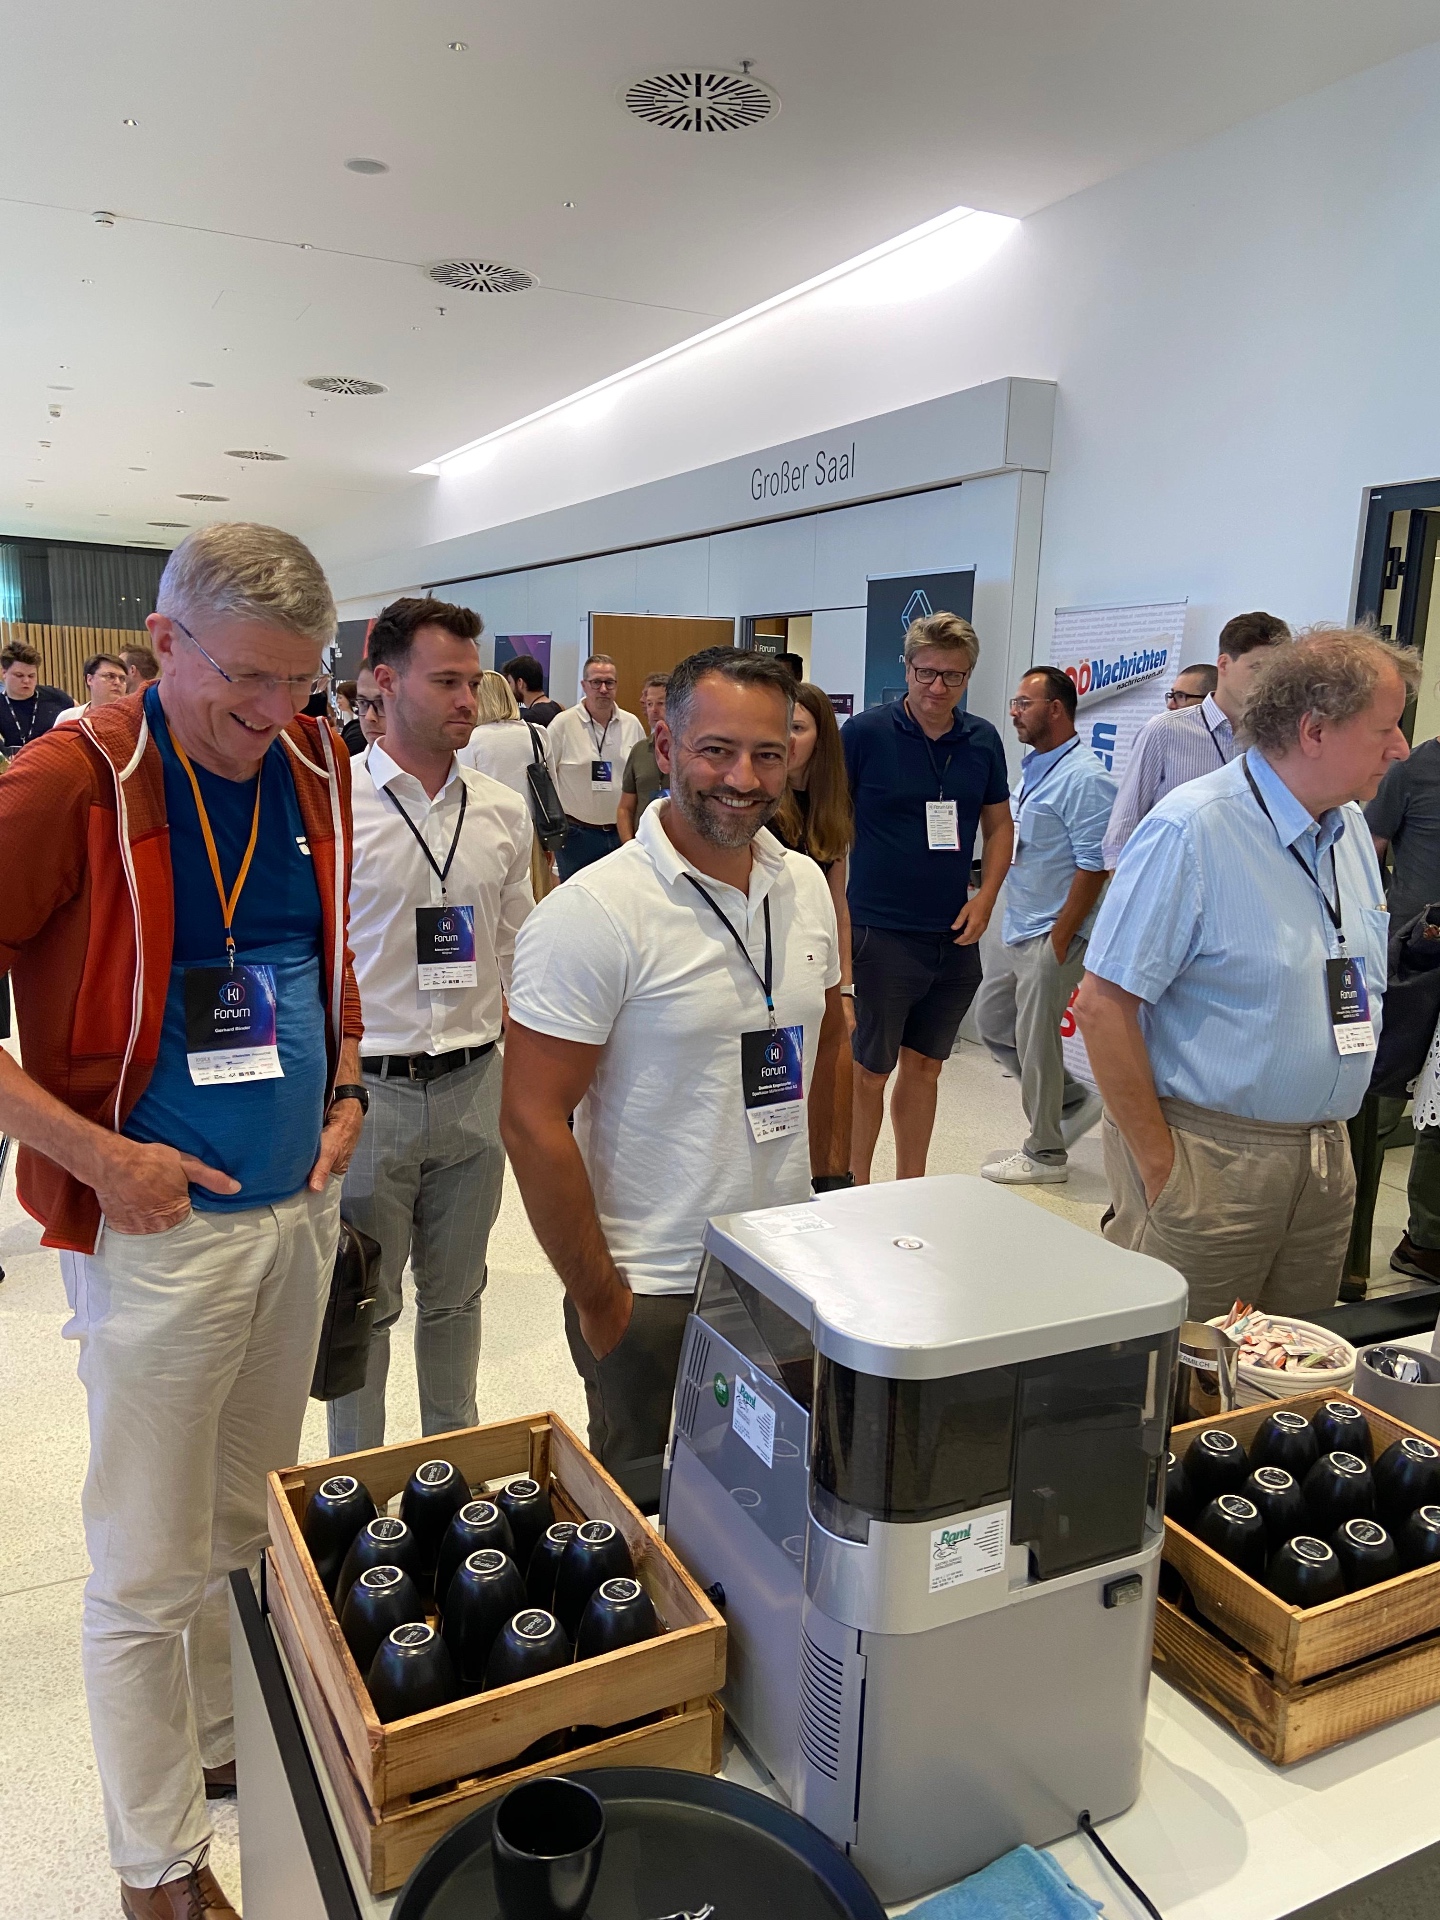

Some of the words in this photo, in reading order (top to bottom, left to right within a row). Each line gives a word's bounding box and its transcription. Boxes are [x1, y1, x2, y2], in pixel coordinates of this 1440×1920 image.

[751, 460, 809, 500] Großer
[814, 442, 856, 486] Saal
[759, 644, 776, 653] Forum
[1116, 668, 1164, 691] nachrichten.at
[434, 934, 459, 943] Forum
[227, 987, 239, 1001] KI
[1340, 990, 1358, 1000] Forum
[214, 1007, 251, 1020] Forum
[770, 1047, 779, 1060] KI
[761, 1065, 787, 1077] Forum
[523, 1616, 543, 1634] APS
